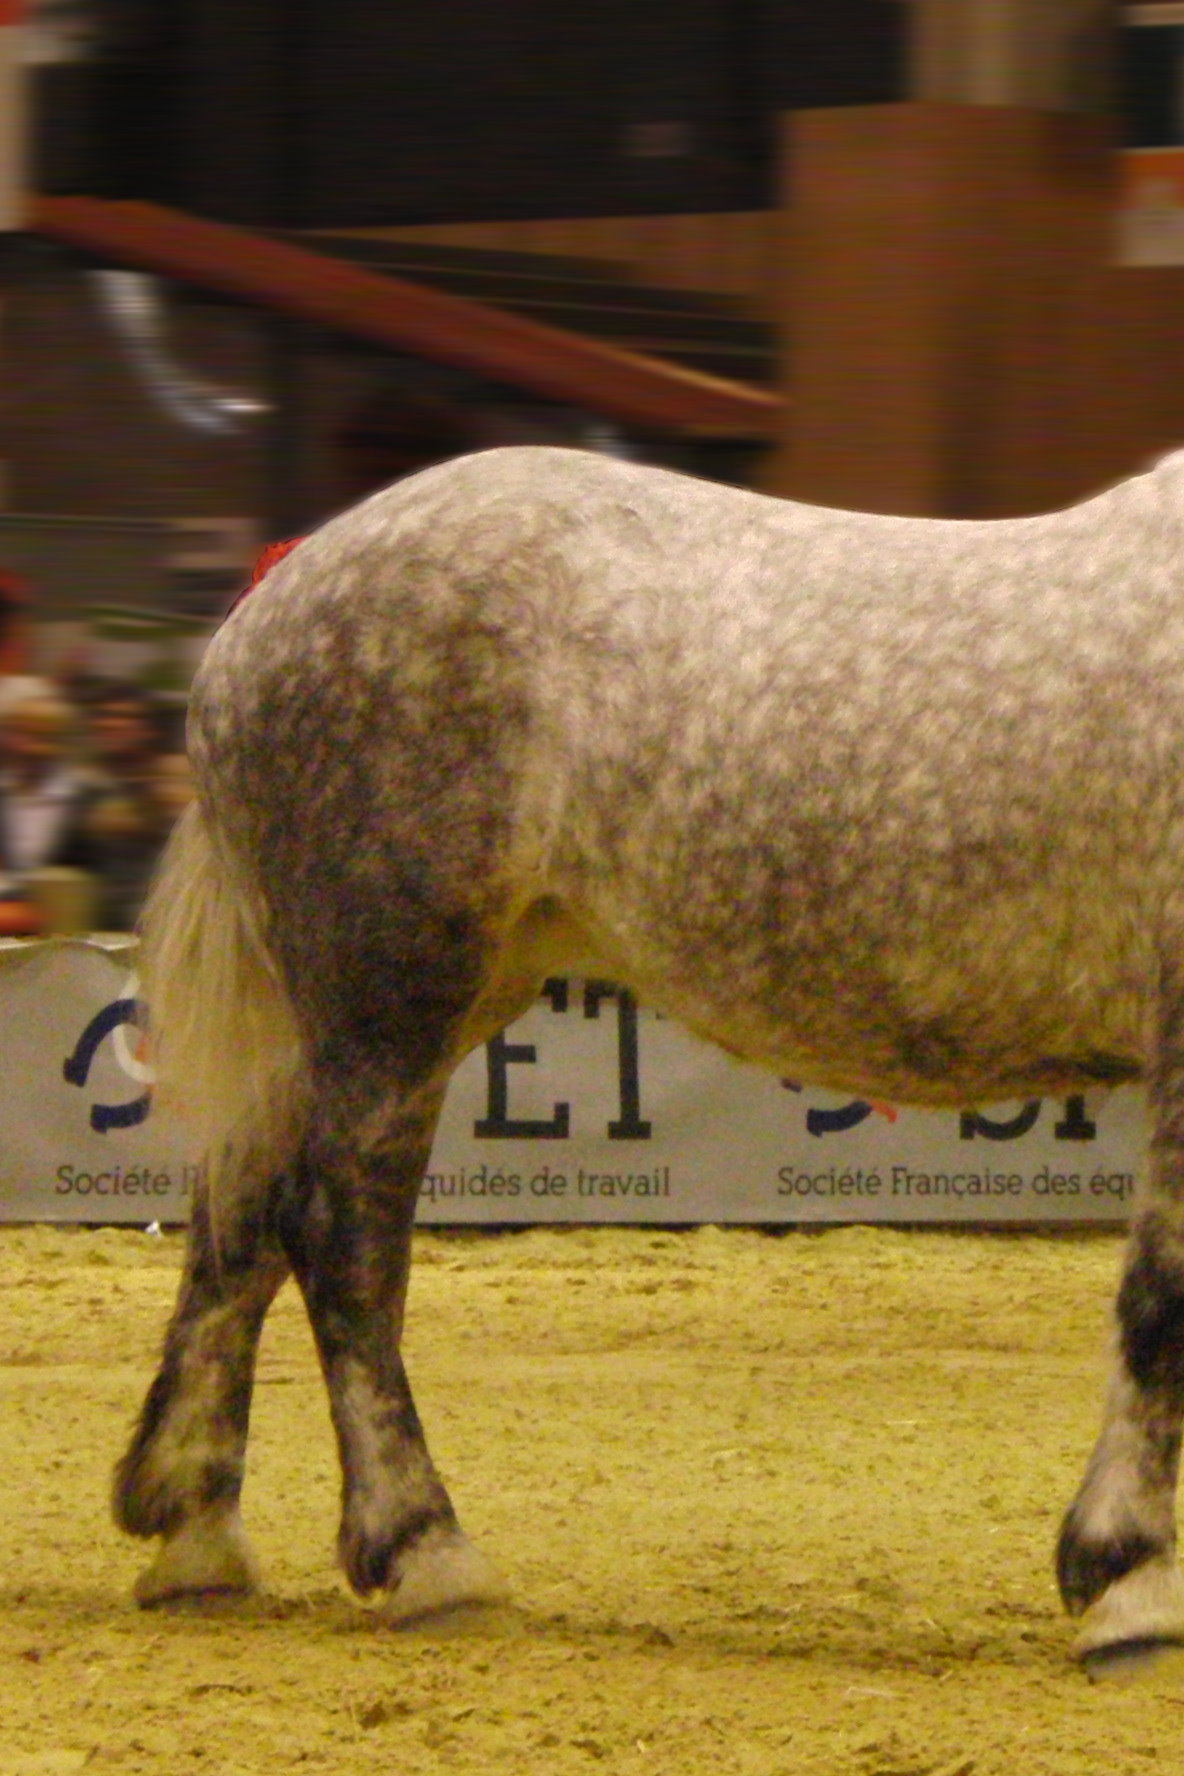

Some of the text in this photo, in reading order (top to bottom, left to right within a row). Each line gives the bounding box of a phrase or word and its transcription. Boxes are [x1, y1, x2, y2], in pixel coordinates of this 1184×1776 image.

[474, 977, 652, 1140] ET
[55, 1165, 171, 1195] Société
[418, 1165, 521, 1202] quidés
[530, 1166, 567, 1197] de
[577, 1166, 670, 1197] travail
[777, 1166, 882, 1196] Société
[891, 1166, 1022, 1201] Française
[1032, 1166, 1081, 1196] des
